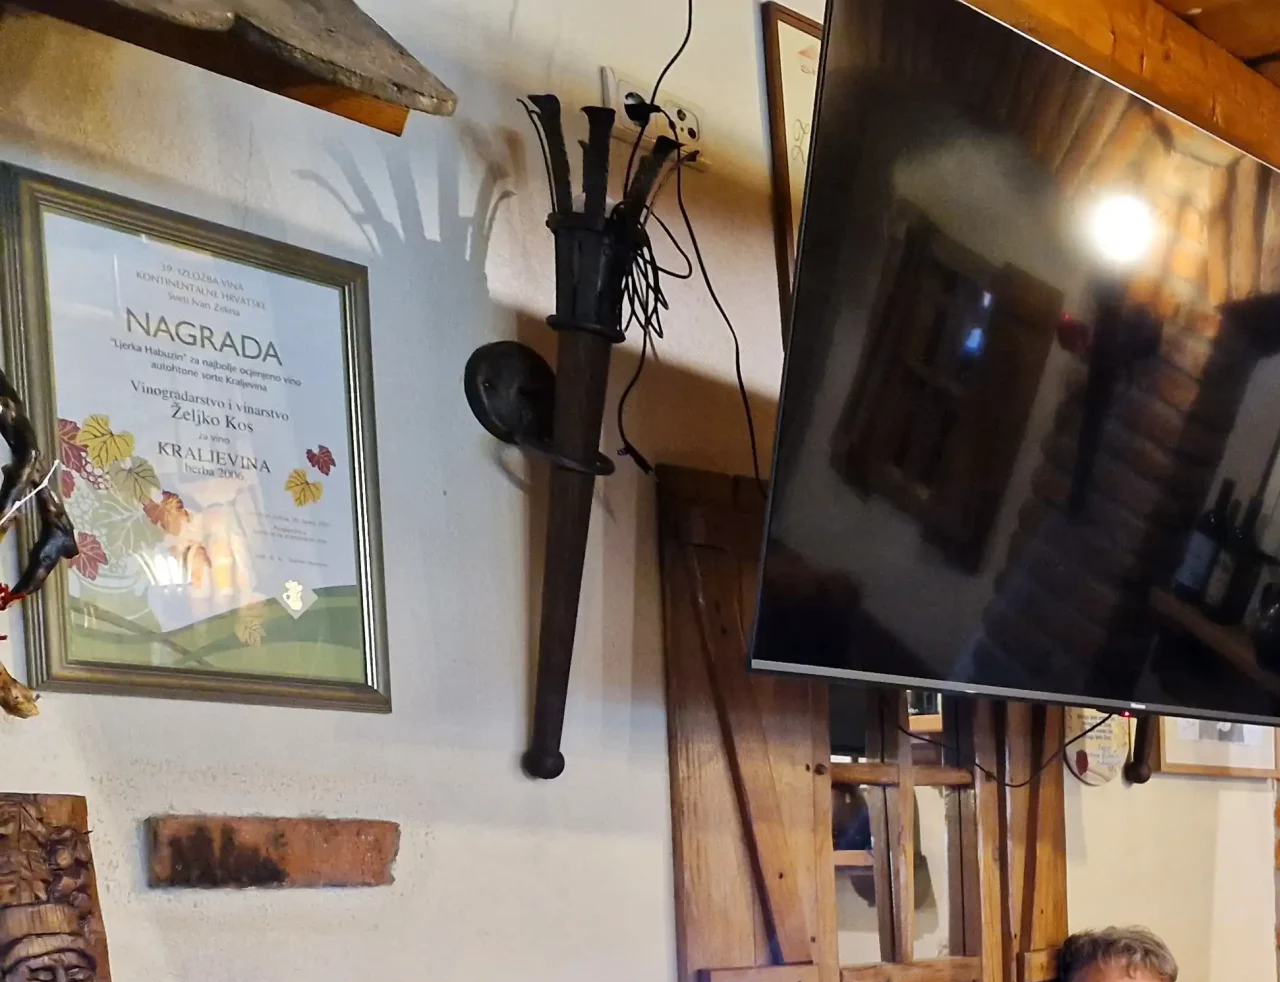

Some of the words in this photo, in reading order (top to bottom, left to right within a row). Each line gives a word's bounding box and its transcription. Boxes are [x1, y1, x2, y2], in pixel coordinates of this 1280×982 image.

[136, 270, 219, 299] KONTINENTALNE
[221, 291, 266, 311] HRVATSKE
[221, 279, 244, 291] VINA
[167, 291, 190, 303] Sveti
[191, 297, 211, 310] Ivan
[213, 303, 241, 316] Zelina
[126, 307, 283, 366] NAGRADA
[151, 361, 199, 378] autohtone
[201, 372, 224, 384] sorte
[225, 376, 268, 393] Kraljevina
[190, 356, 200, 365] za
[202, 358, 237, 374] najbolje
[239, 367, 281, 384] ocjenjeno
[283, 376, 302, 387] vino
[130, 379, 225, 410] Vinogradarstvo
[236, 402, 290, 422] vinarstvo
[171, 402, 220, 427] Željko
[225, 414, 254, 433] Kos
[198, 433, 209, 441] za
[211, 434, 231, 445] vino
[157, 441, 272, 474] KRALJEVINA
[184, 462, 215, 477] berba
